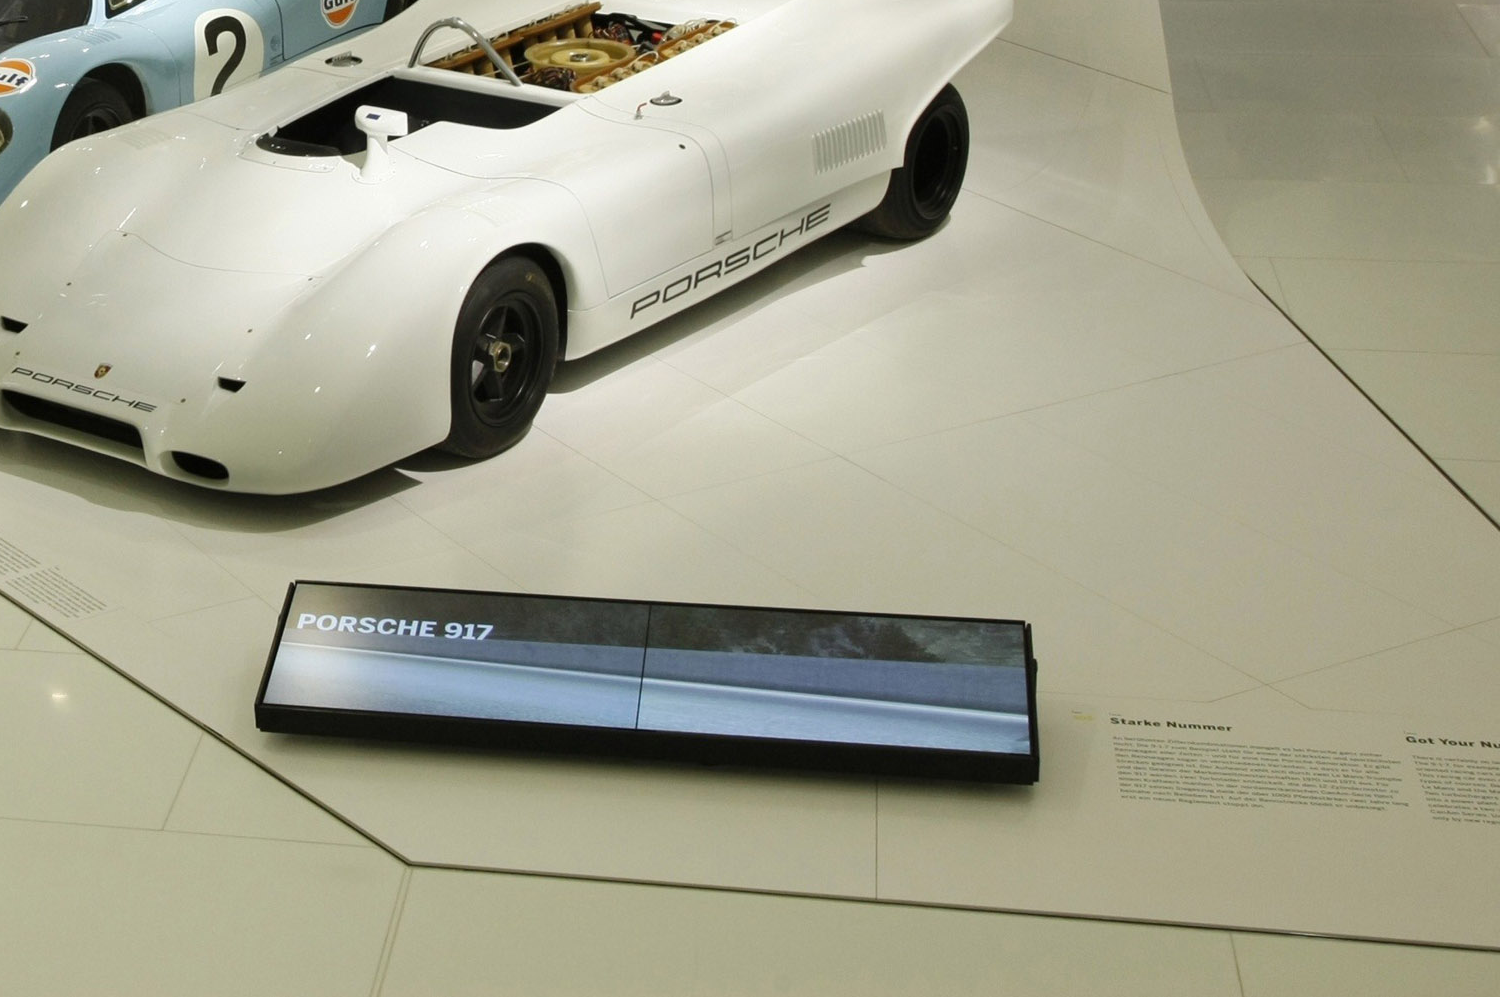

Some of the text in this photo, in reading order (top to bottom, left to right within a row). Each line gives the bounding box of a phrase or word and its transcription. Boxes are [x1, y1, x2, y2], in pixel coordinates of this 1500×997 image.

[204, 15, 247, 97] 2
[629, 203, 832, 320] PORSCHE
[11, 366, 158, 413] PORSCHE
[296, 614, 494, 642] PORSCHE 917
[1109, 716, 1233, 733] Starke Nummer
[1405, 735, 1435, 745] Got
[1438, 738, 1475, 748] Your
